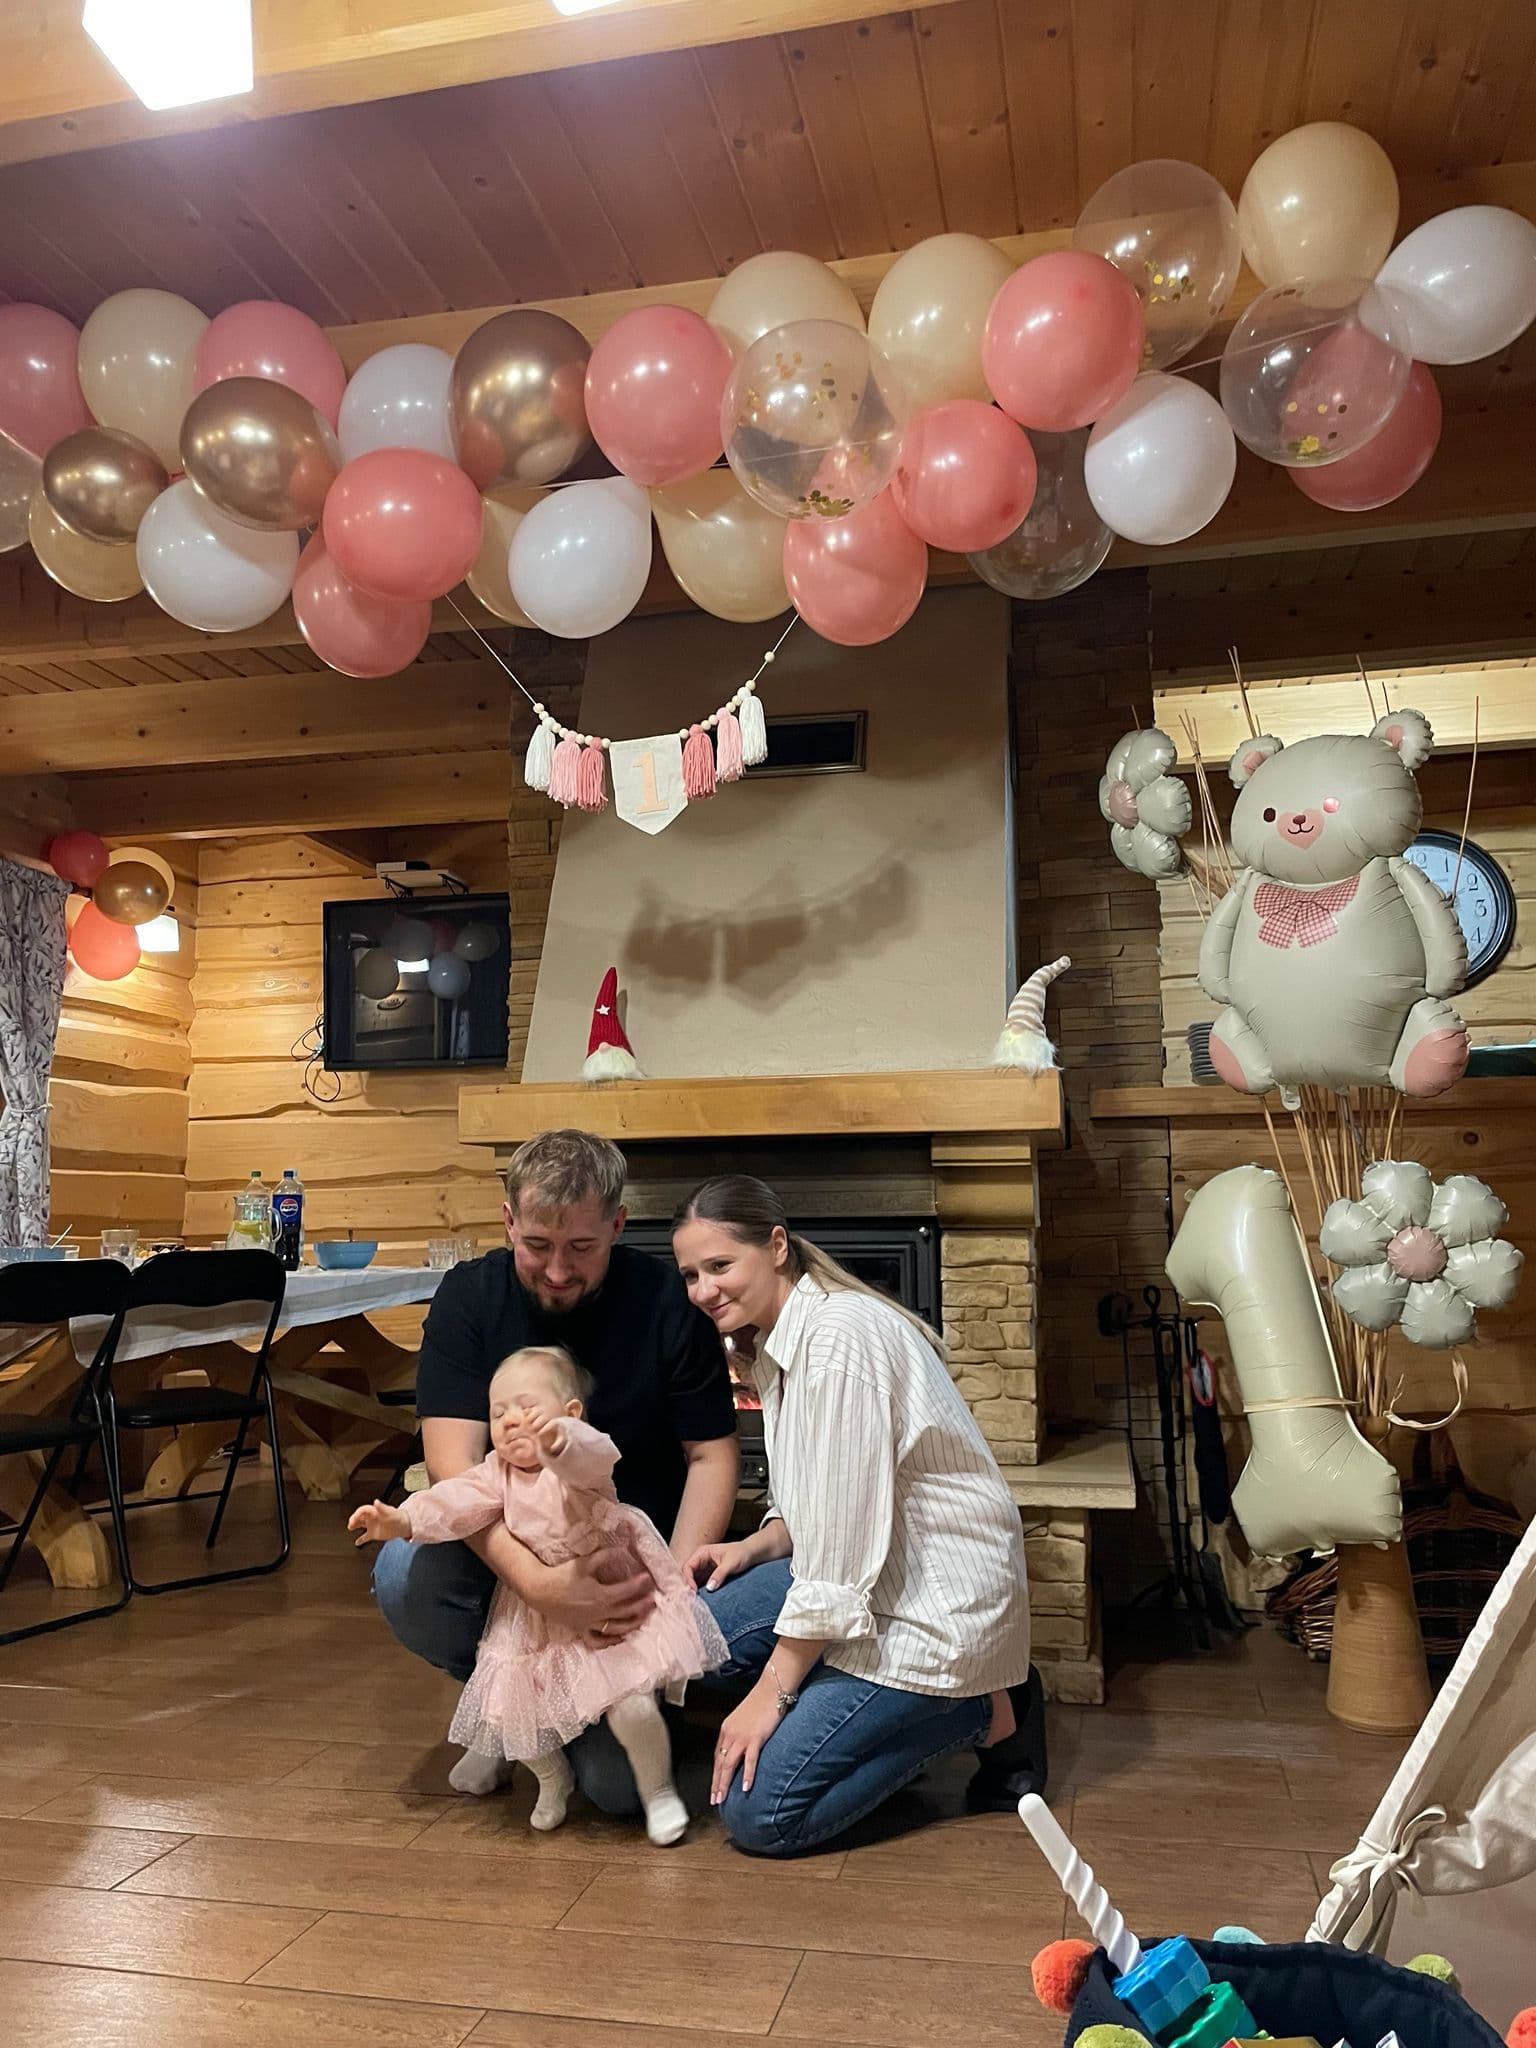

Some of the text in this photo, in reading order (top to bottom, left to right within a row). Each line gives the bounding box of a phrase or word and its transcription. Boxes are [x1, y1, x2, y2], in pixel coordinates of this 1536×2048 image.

[633, 751, 669, 815] 1
[1466, 873, 1479, 891] 2
[1474, 899, 1487, 917] 3
[1470, 926, 1482, 944] 4
[1165, 1163, 1403, 1561] 1
